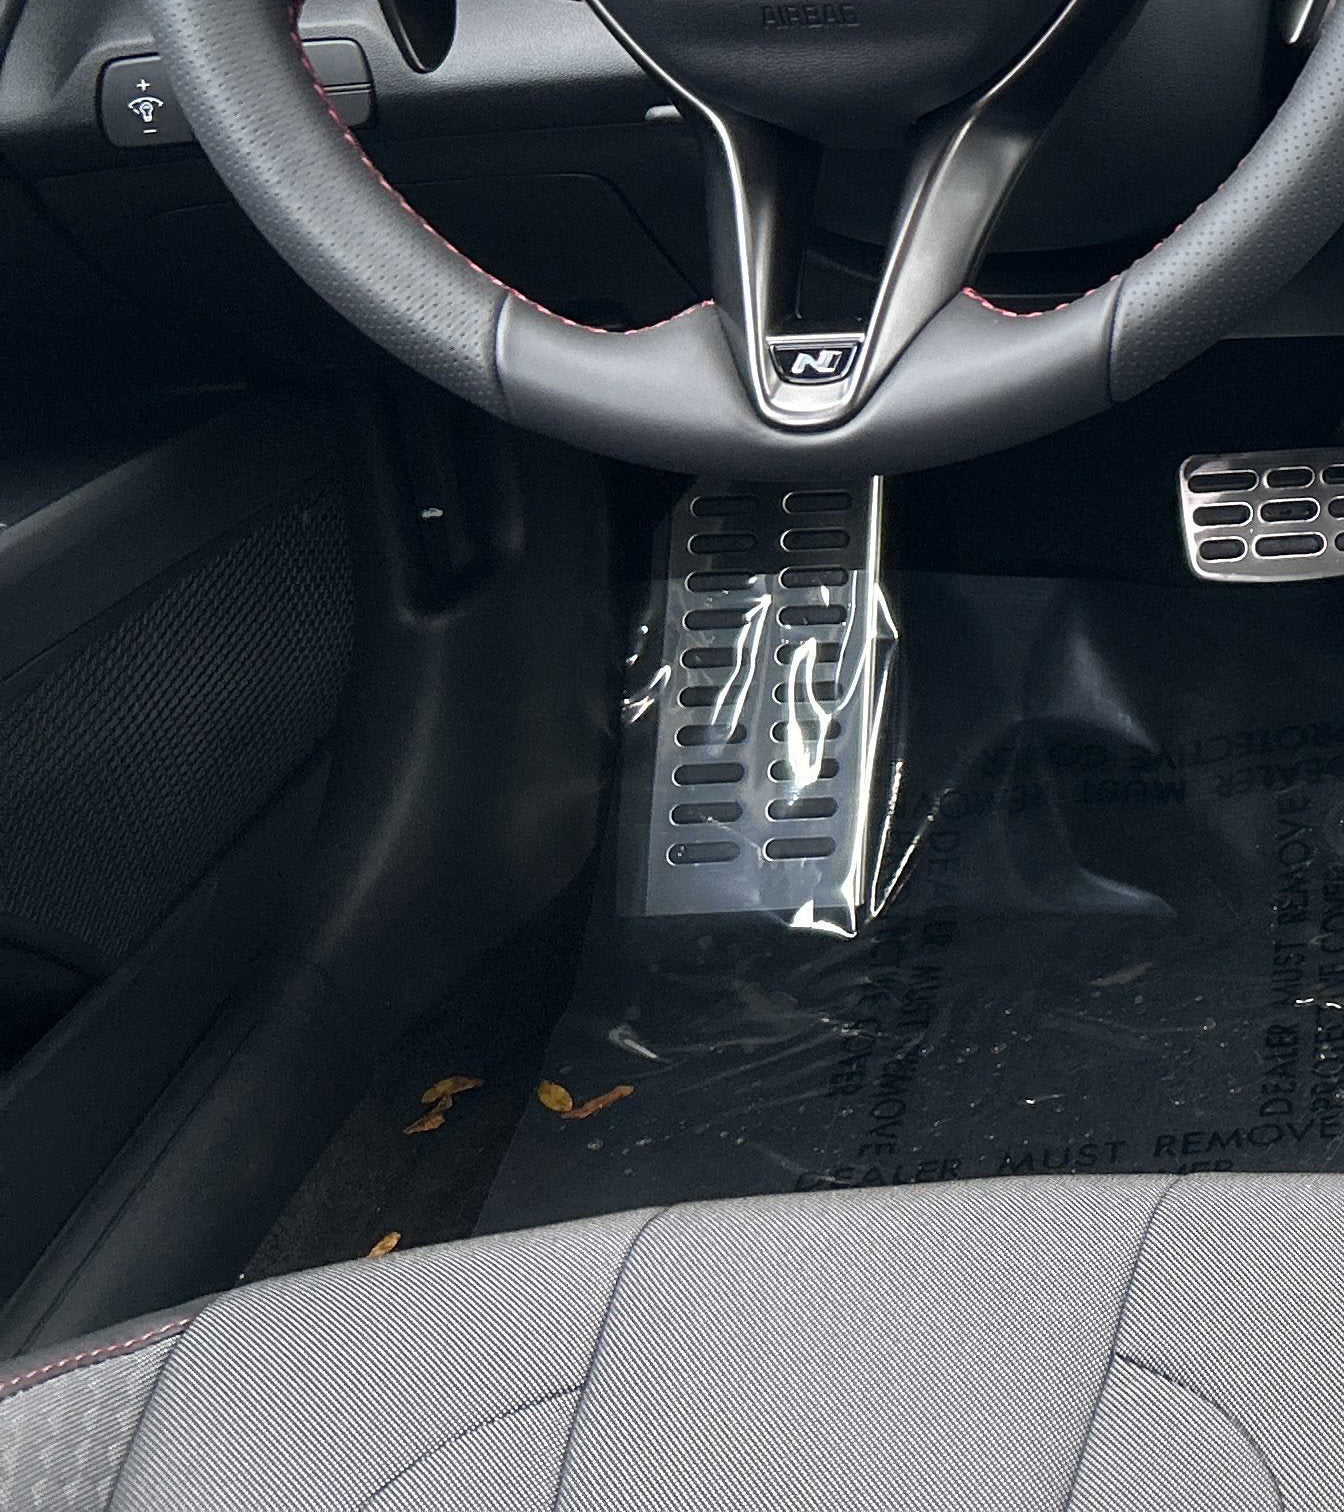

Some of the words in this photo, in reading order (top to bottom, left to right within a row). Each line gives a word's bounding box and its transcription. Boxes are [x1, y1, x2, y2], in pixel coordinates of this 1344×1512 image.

[761, 3, 860, 30] AIRBAG
[1275, 794, 1313, 926] REMOVE
[1270, 940, 1308, 1008] MUST
[1259, 1023, 1299, 1118] DEALER
[1000, 1141, 1126, 1174] MUST
[1153, 1117, 1342, 1159] REMOVE
